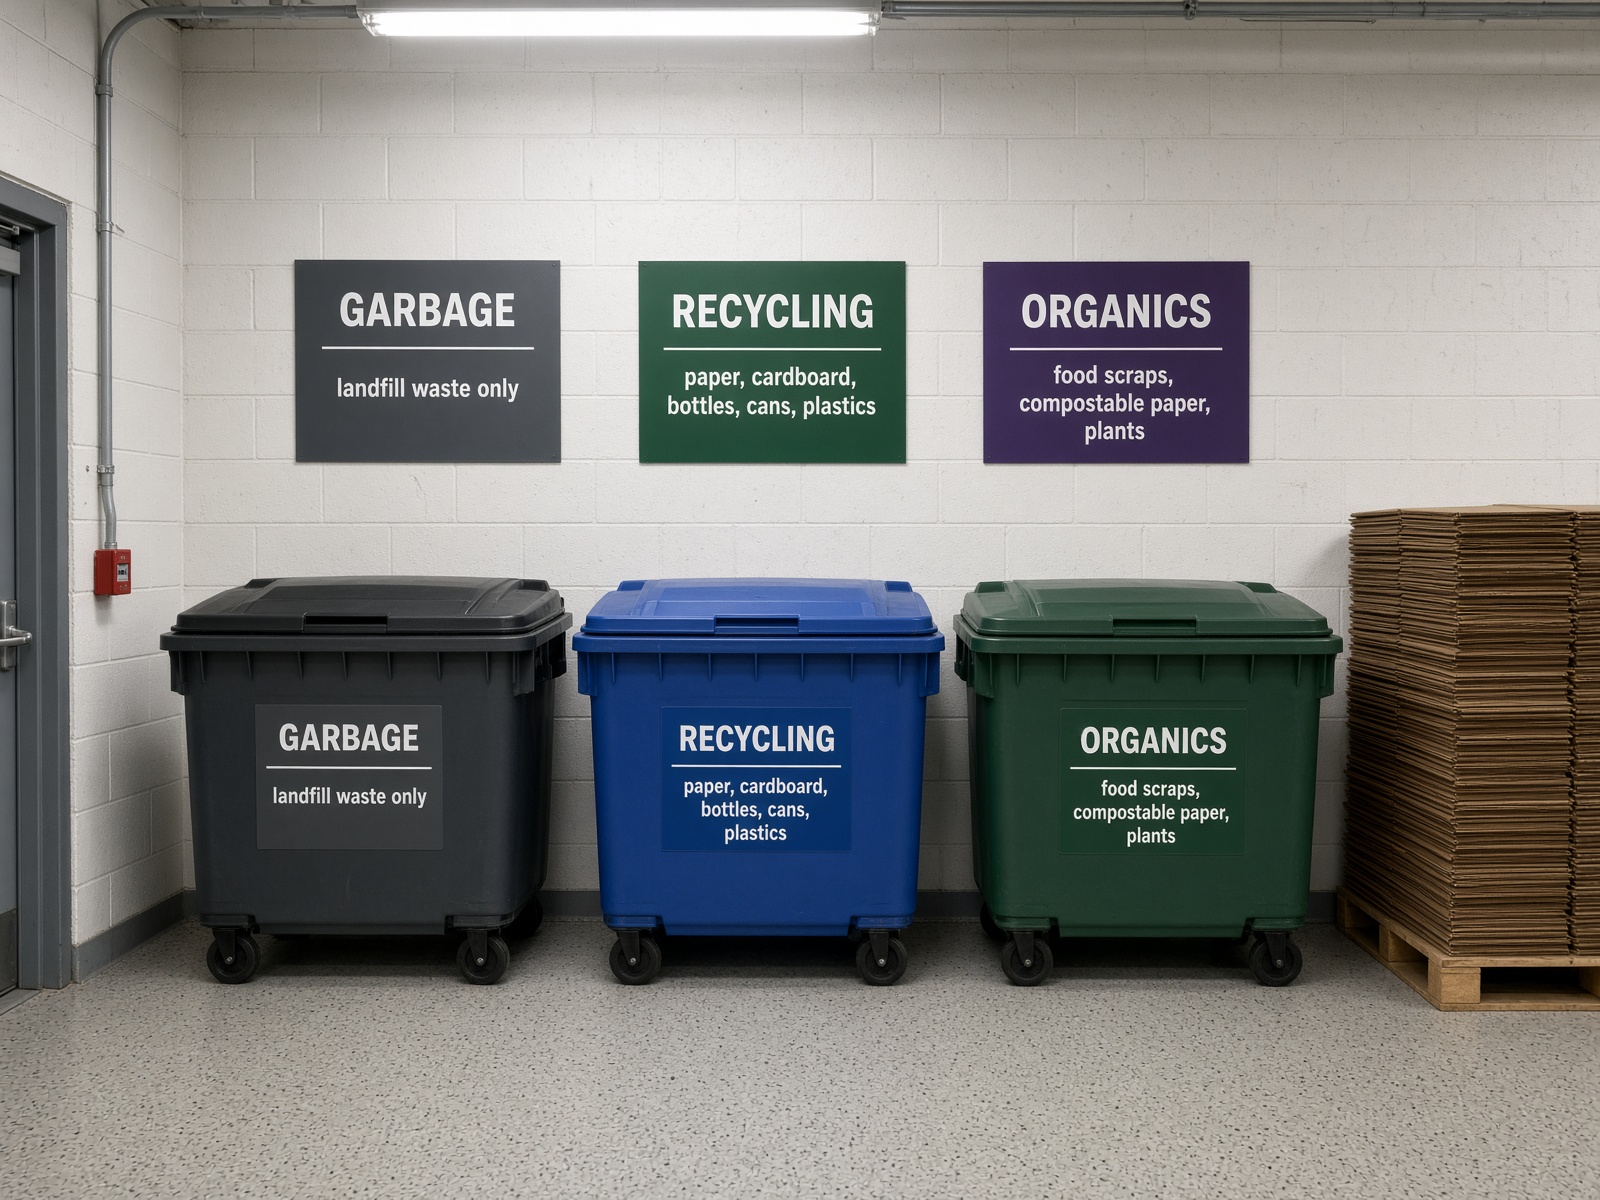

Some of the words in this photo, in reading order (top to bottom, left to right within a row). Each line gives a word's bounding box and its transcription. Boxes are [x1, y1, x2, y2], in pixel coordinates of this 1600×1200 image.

[339, 291, 515, 328] GARBAGE
[672, 293, 874, 329] RECYCLING
[1021, 293, 1212, 329] ORGANICS
[684, 371, 745, 391] paper,
[751, 365, 856, 390] cardboard,
[1053, 364, 1098, 385] food
[1104, 369, 1173, 389] scraps,
[337, 377, 405, 398] landfill
[411, 379, 471, 398] waste
[477, 377, 520, 403] only
[667, 394, 740, 419] bottles,
[746, 400, 796, 419] cans,
[803, 395, 876, 420] plastics
[1019, 392, 1145, 417] compostable
[1150, 397, 1211, 417] paper,
[1084, 420, 1146, 446] plants
[278, 722, 420, 752] GARBAGE
[678, 724, 836, 753] RECYCLING
[1080, 726, 1228, 755] ORGANICS
[272, 786, 332, 805] landfill
[335, 788, 388, 806] waste
[391, 787, 428, 809] only
[683, 781, 736, 798] paper,
[739, 777, 829, 797] cardboard,
[1100, 779, 1139, 797] food
[1142, 783, 1201, 801] scraps,
[700, 800, 763, 821] bottles,
[767, 804, 811, 821] cans,
[1072, 803, 1177, 824] compostable
[1180, 807, 1230, 825] paper,
[723, 823, 788, 845] plastics
[1126, 826, 1177, 848] plants
